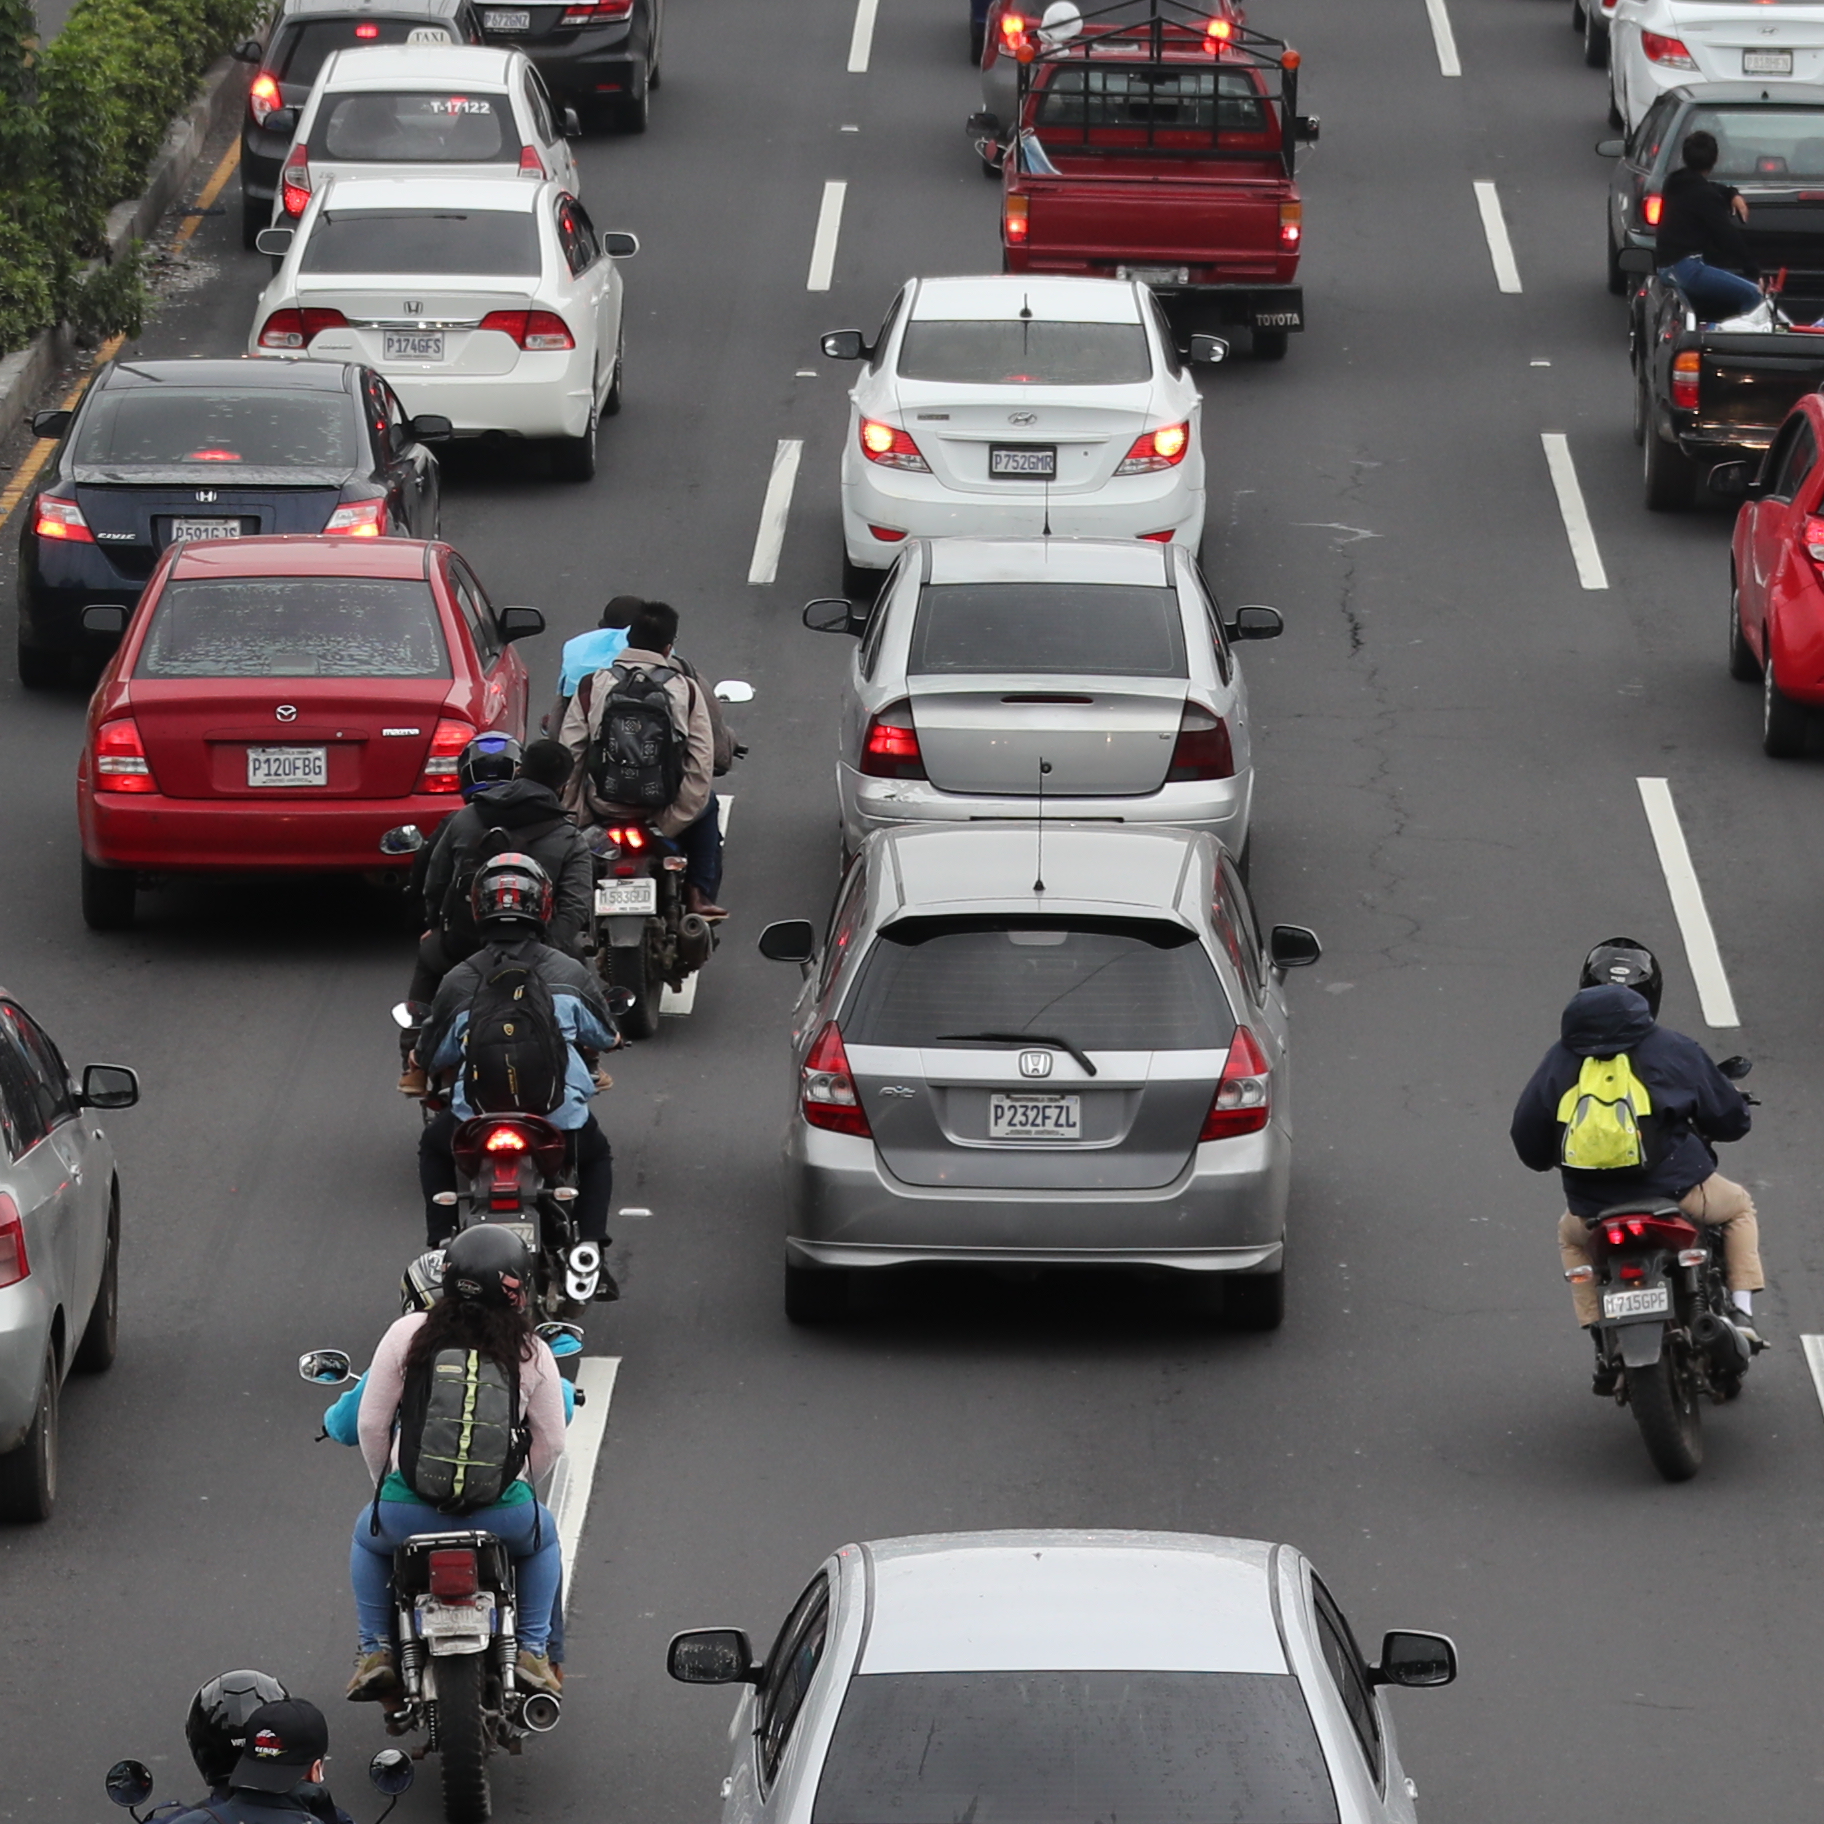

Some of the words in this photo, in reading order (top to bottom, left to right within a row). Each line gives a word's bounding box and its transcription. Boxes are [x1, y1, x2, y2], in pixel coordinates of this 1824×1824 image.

[415, 32, 444, 42] TAXI
[430, 101, 491, 114] T-17122
[1255, 313, 1300, 326] TOYOTA
[994, 453, 1053, 471] P752GMR
[253, 757, 323, 777] P120FBG
[994, 1104, 1077, 1127] P232FZL
